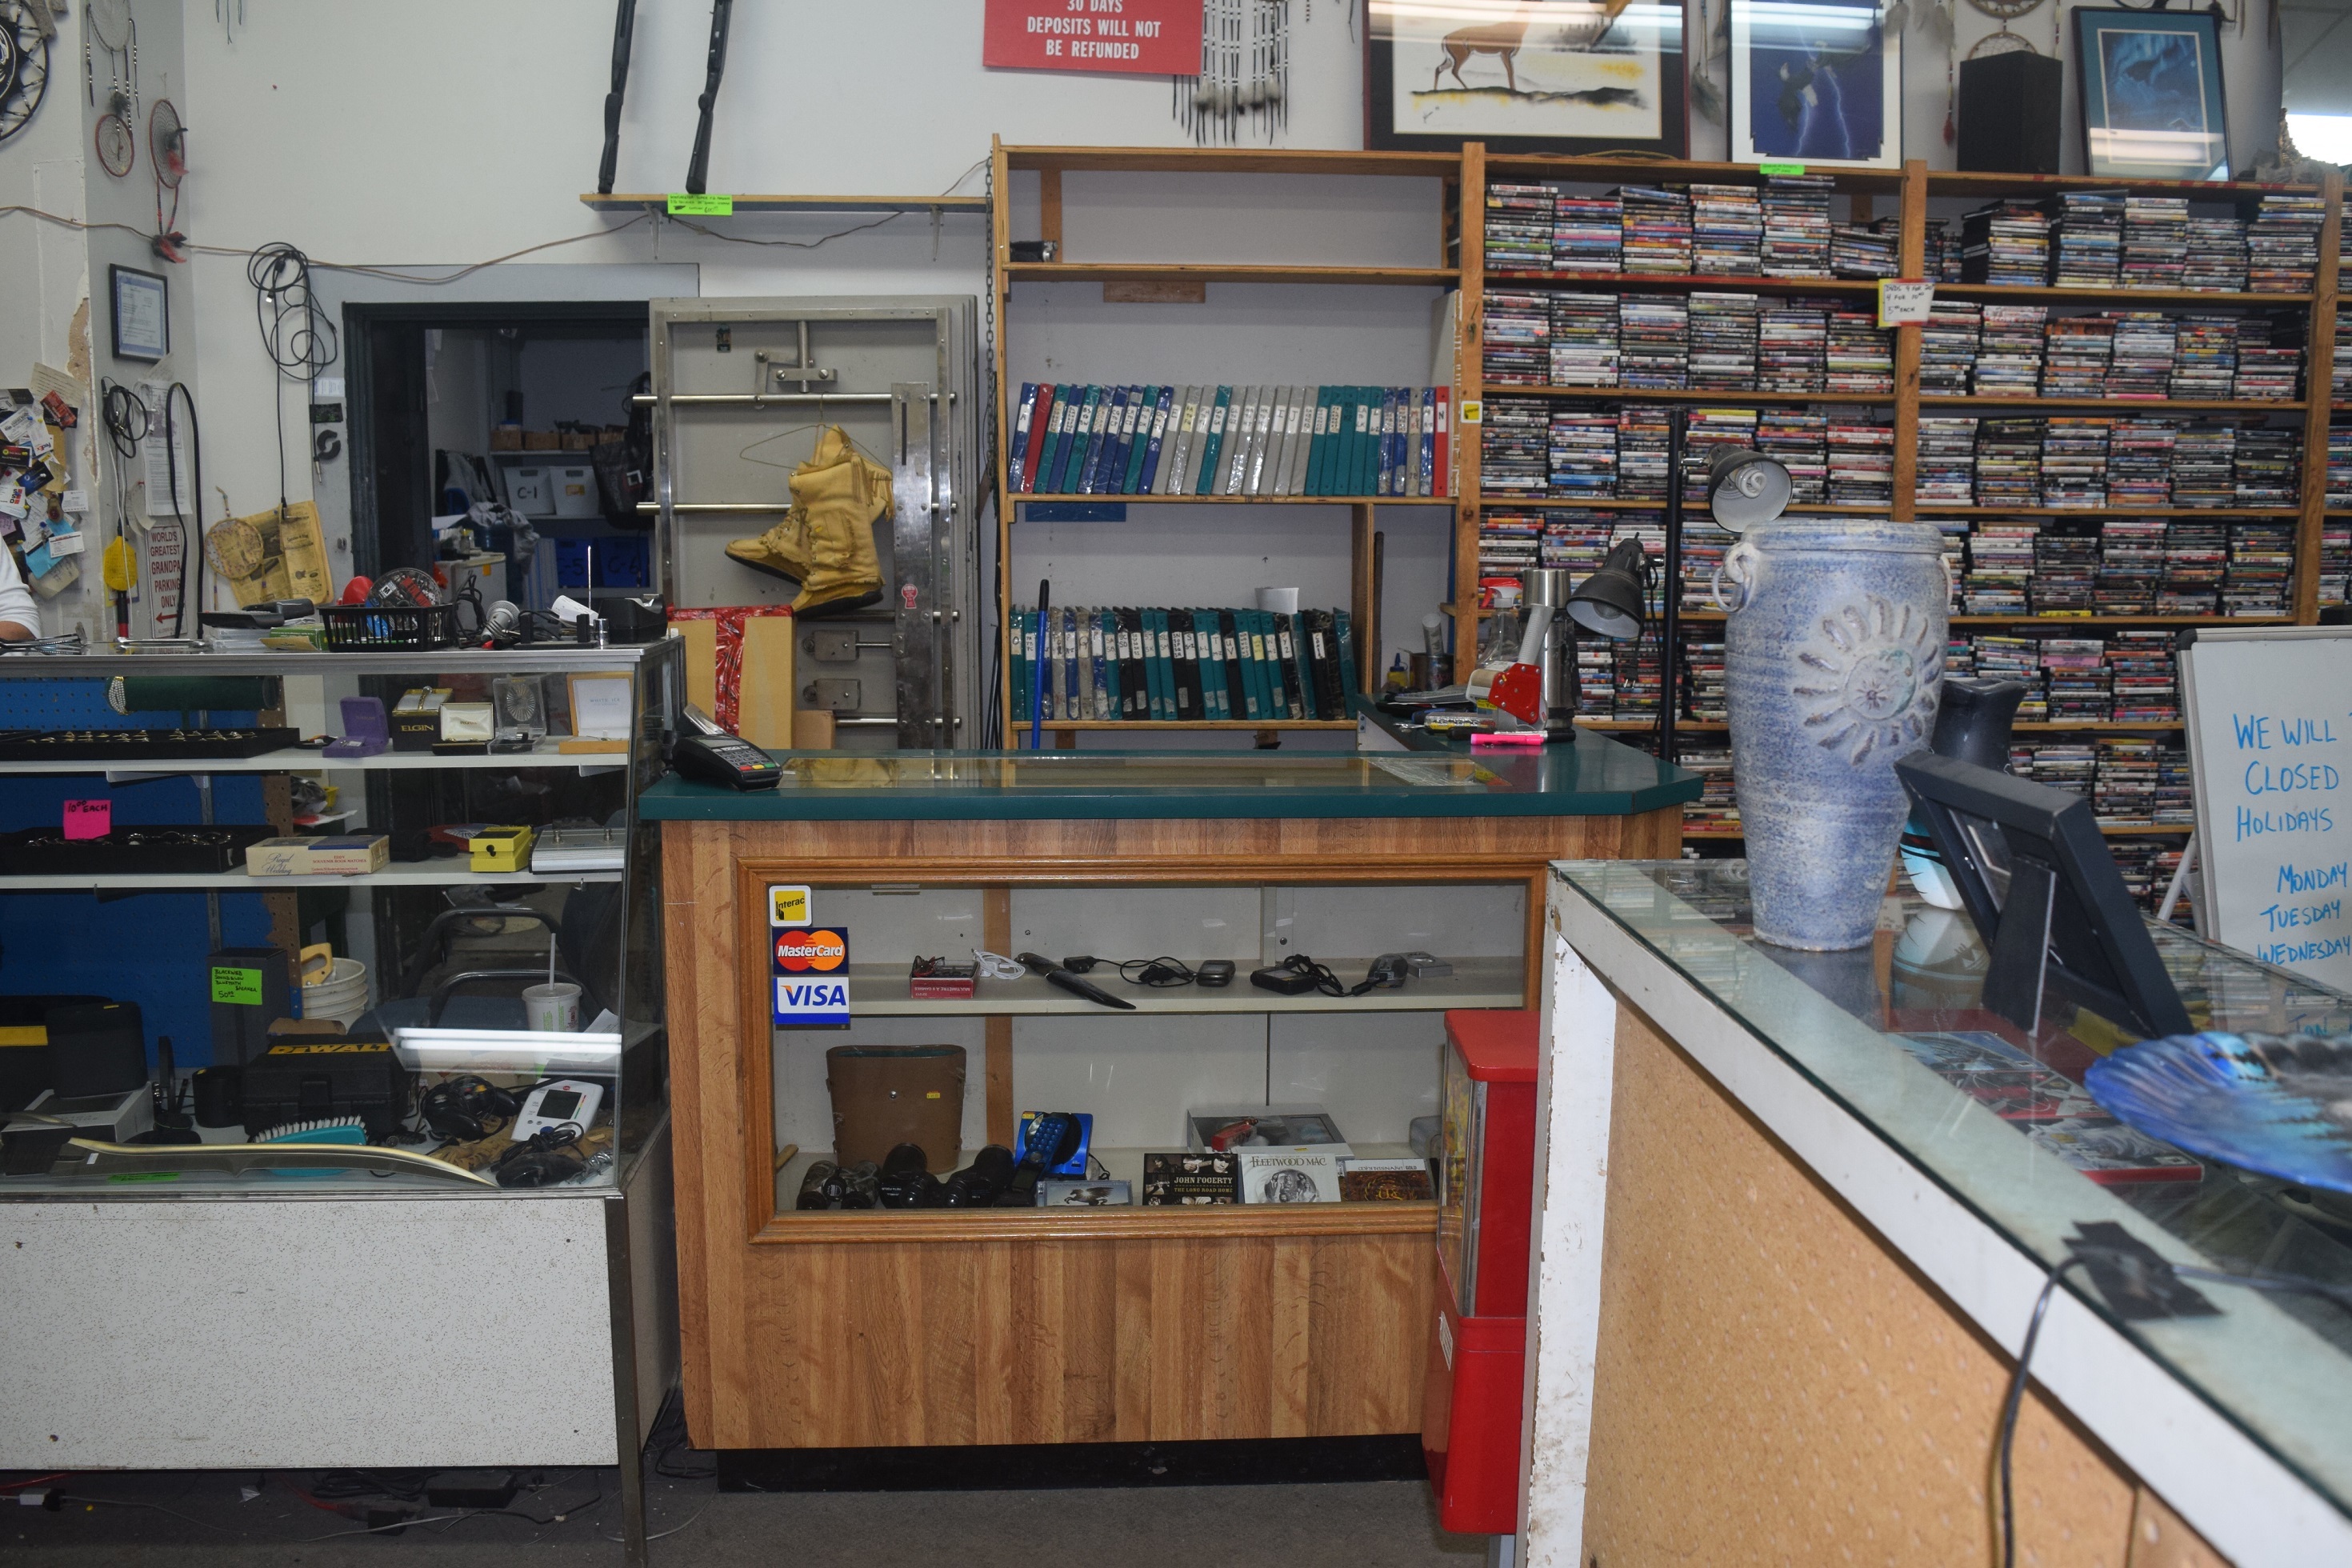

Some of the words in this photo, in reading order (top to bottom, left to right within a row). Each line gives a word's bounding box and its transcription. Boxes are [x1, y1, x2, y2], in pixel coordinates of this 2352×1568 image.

[1067, 0, 1084, 11] 30
[1090, 0, 1122, 13] DAYS
[1026, 16, 1091, 35] DEPOSITS
[1098, 19, 1130, 37] WILL
[1135, 20, 1161, 38] NOT
[1046, 38, 1062, 56] BE
[1070, 40, 1139, 60] REFUNDED
[37, 442, 51, 451] FedEx
[517, 486, 538, 499] C-1
[151, 531, 178, 543] WORLD'S
[150, 545, 181, 557] GREATEST
[151, 560, 182, 575] GRANDPA
[154, 578, 181, 593] PARKING
[161, 595, 176, 609] ONLY
[401, 724, 434, 732] ELGIN
[2233, 714, 2271, 750] WE
[2281, 718, 2337, 746] WILL
[2245, 760, 2339, 795] CLOSED
[82, 804, 108, 813] EACH
[2237, 805, 2333, 842] HOLIDAYS
[2277, 862, 2347, 894] MONDAY
[2259, 898, 2341, 932] TUESDAY
[778, 944, 844, 958] MasterCard
[2258, 935, 2350, 965] WEDNESDAY
[780, 985, 847, 1006] VISA
[1250, 1156, 1305, 1167] FLEETWOOD
[1306, 1158, 1326, 1166] MAC
